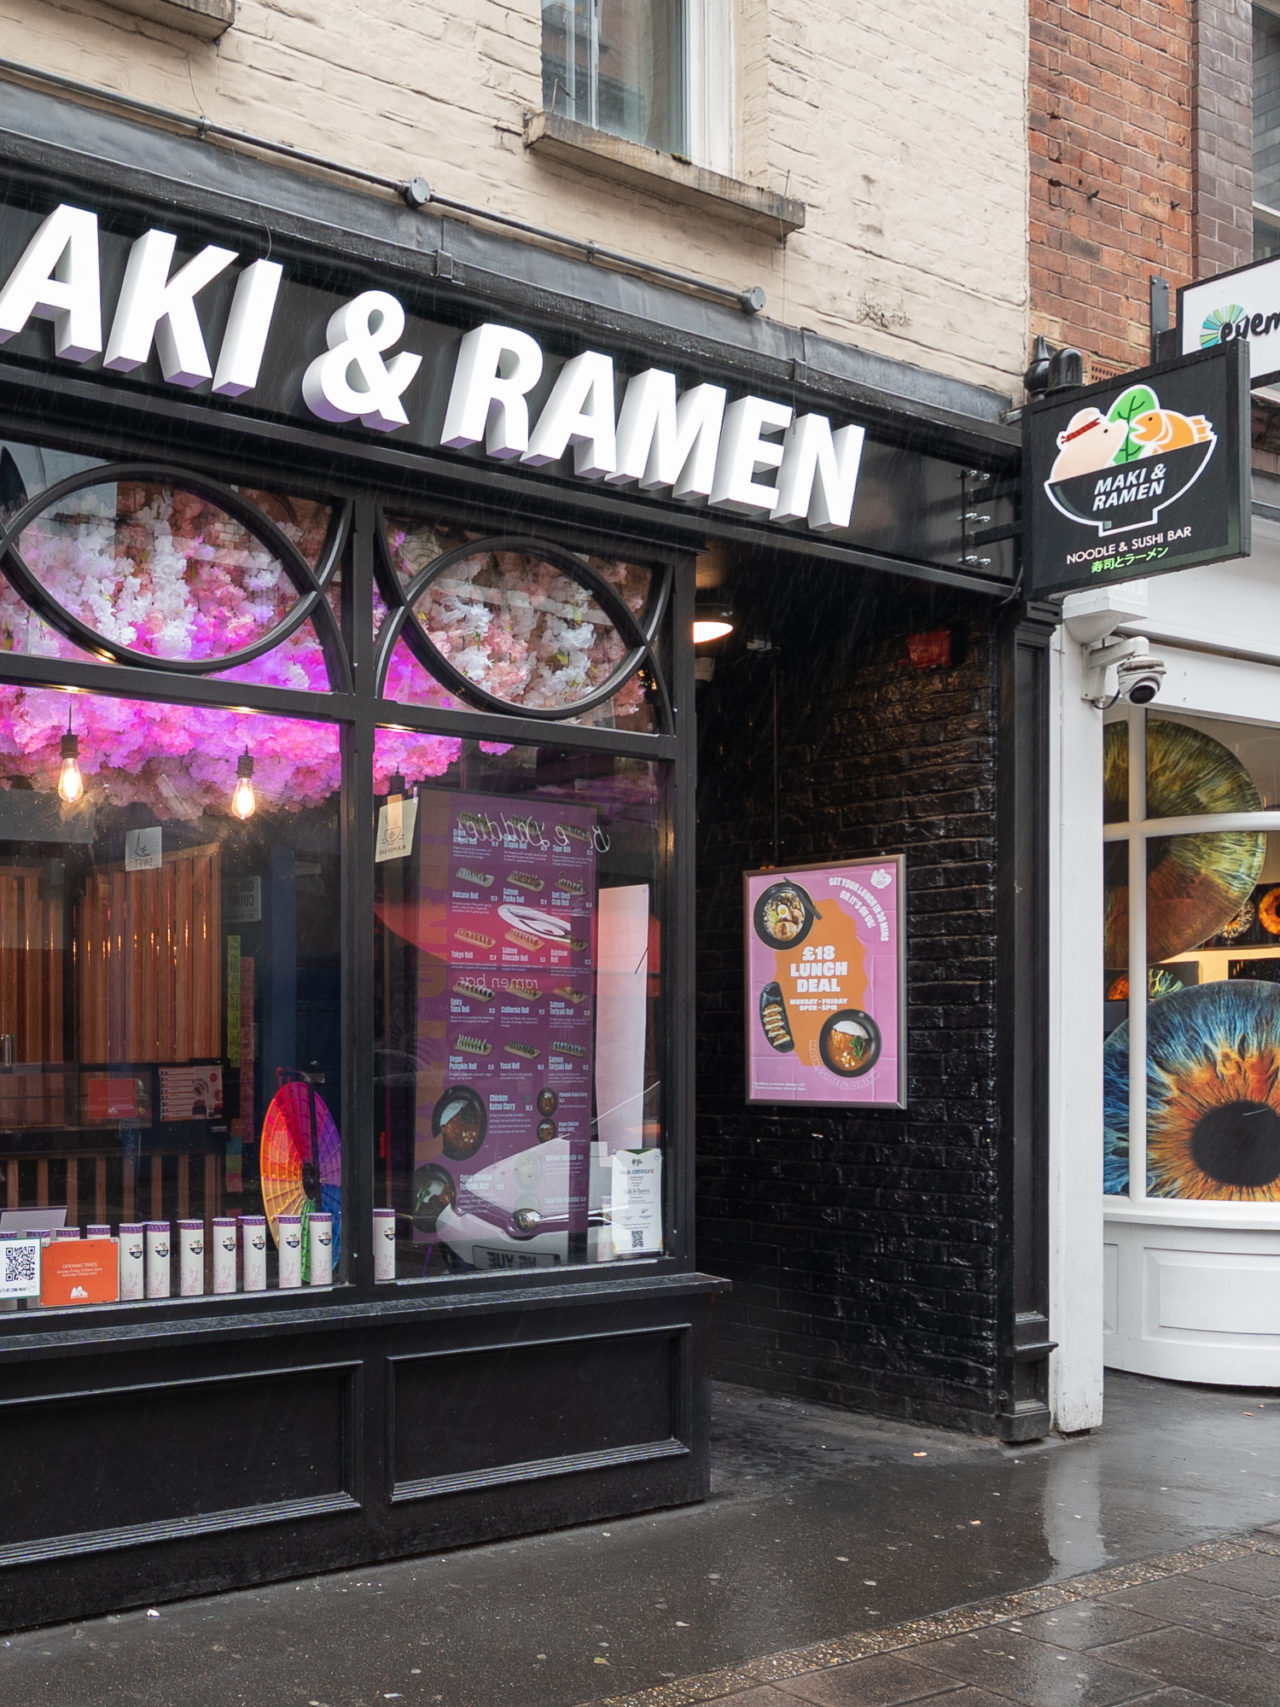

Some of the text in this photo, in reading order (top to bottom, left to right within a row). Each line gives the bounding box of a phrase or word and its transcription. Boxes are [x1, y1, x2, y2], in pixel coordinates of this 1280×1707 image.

[301, 289, 423, 432] &
[440, 322, 865, 532] RAMEN
[1094, 463, 1168, 495] MAKI &
[1092, 479, 1165, 512] RAMEN
[1066, 526, 1192, 565] NOODLE & SUSHI BAR
[1091, 546, 1169, 574] 寿司とラーメン
[802, 945, 836, 961] £18
[790, 961, 848, 978] LUNCH
[796, 978, 840, 993] DEAL
